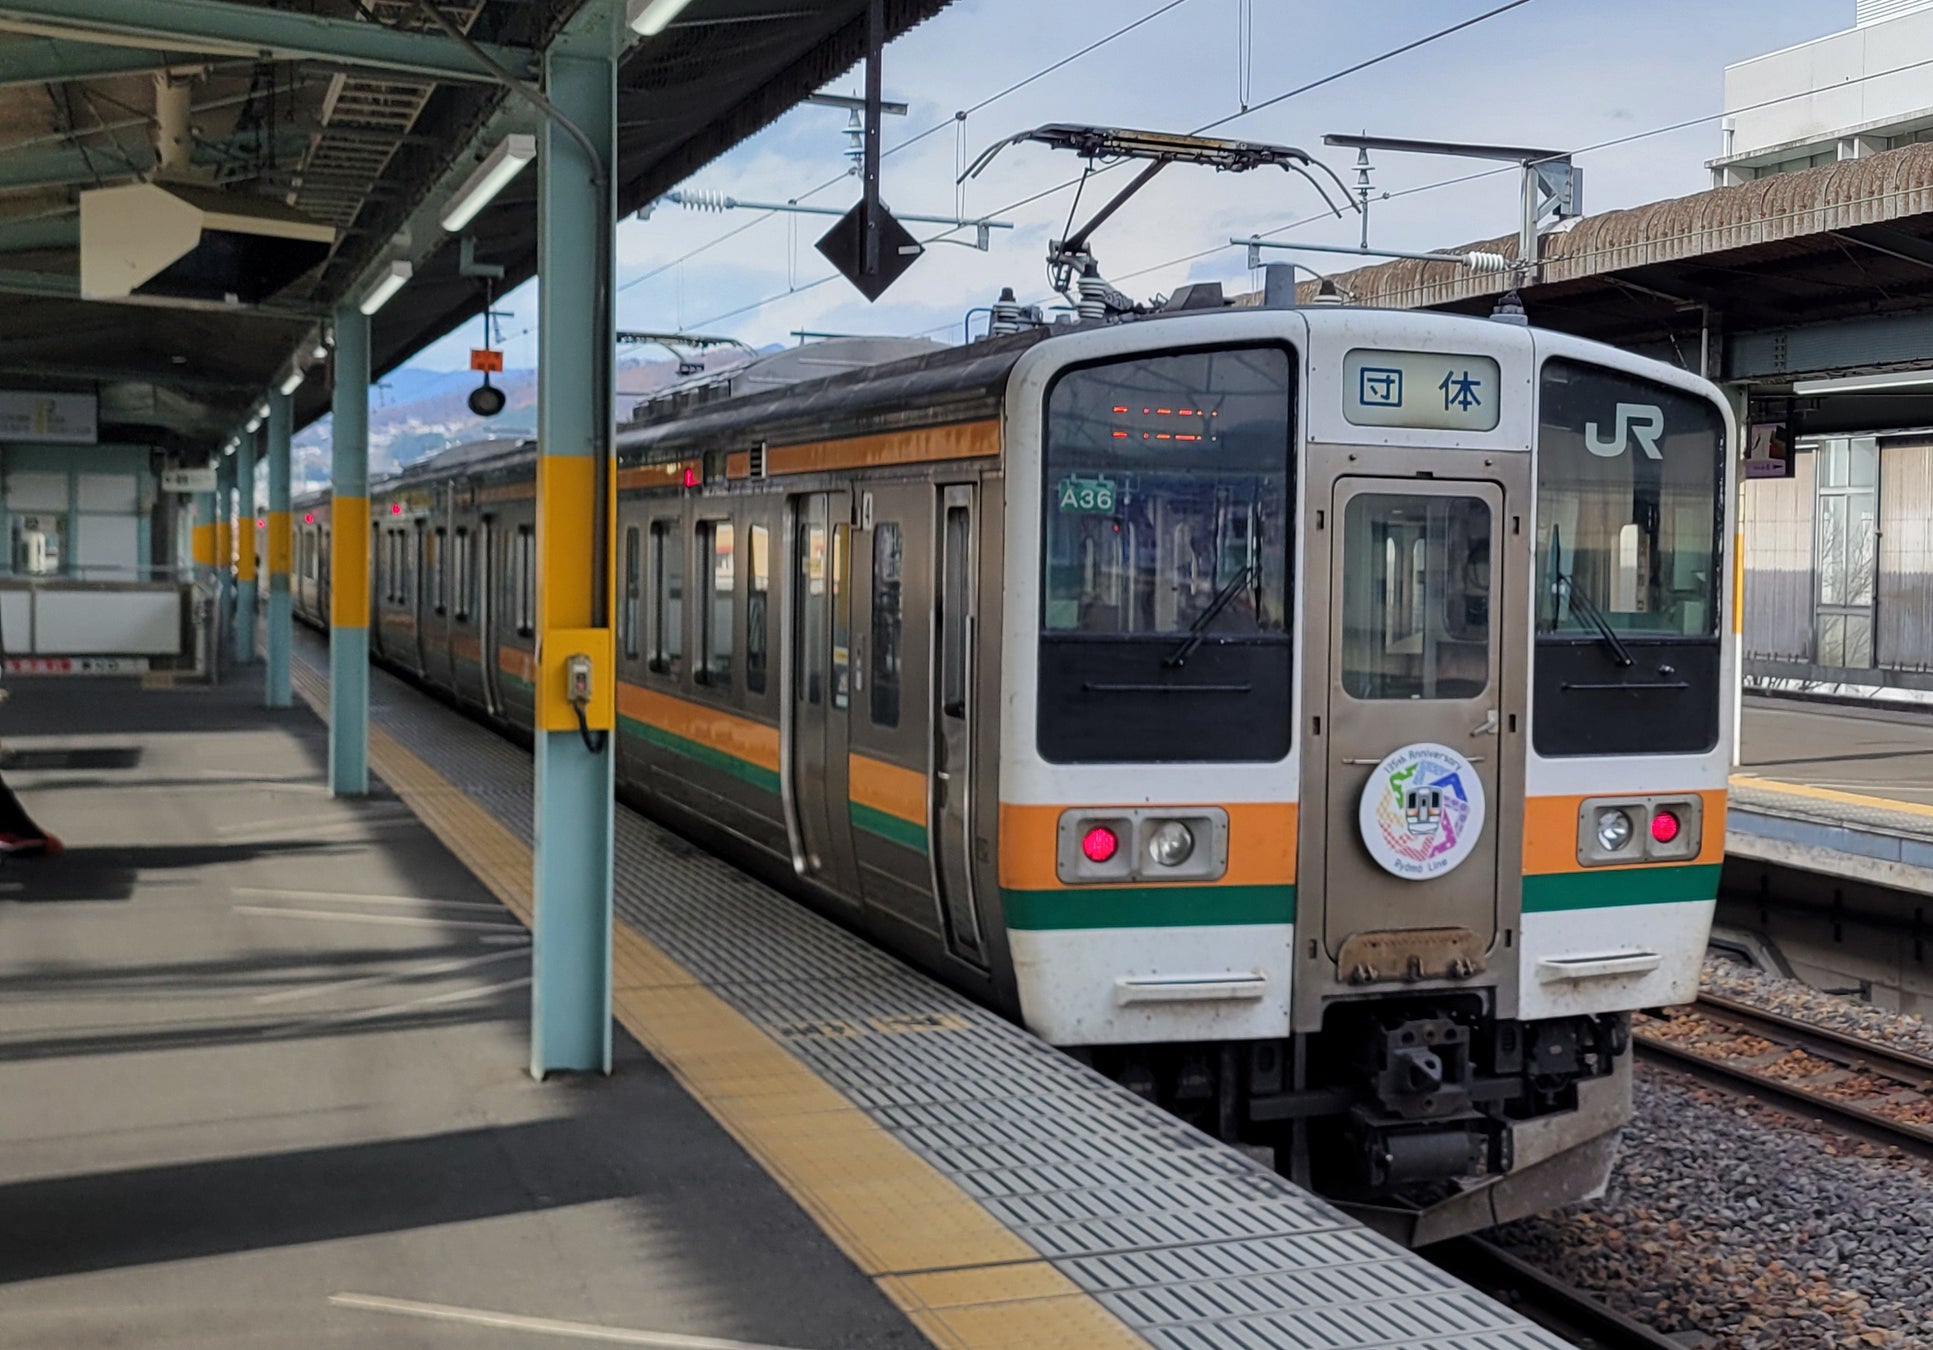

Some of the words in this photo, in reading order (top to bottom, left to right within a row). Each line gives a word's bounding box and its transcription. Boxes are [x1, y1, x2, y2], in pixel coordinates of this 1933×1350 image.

[1360, 367, 1481, 412] 団体
[1585, 402, 1664, 460] JR
[1060, 488, 1112, 509] A36
[1408, 750, 1462, 771] Anniversary
[1427, 858, 1448, 872] Line
